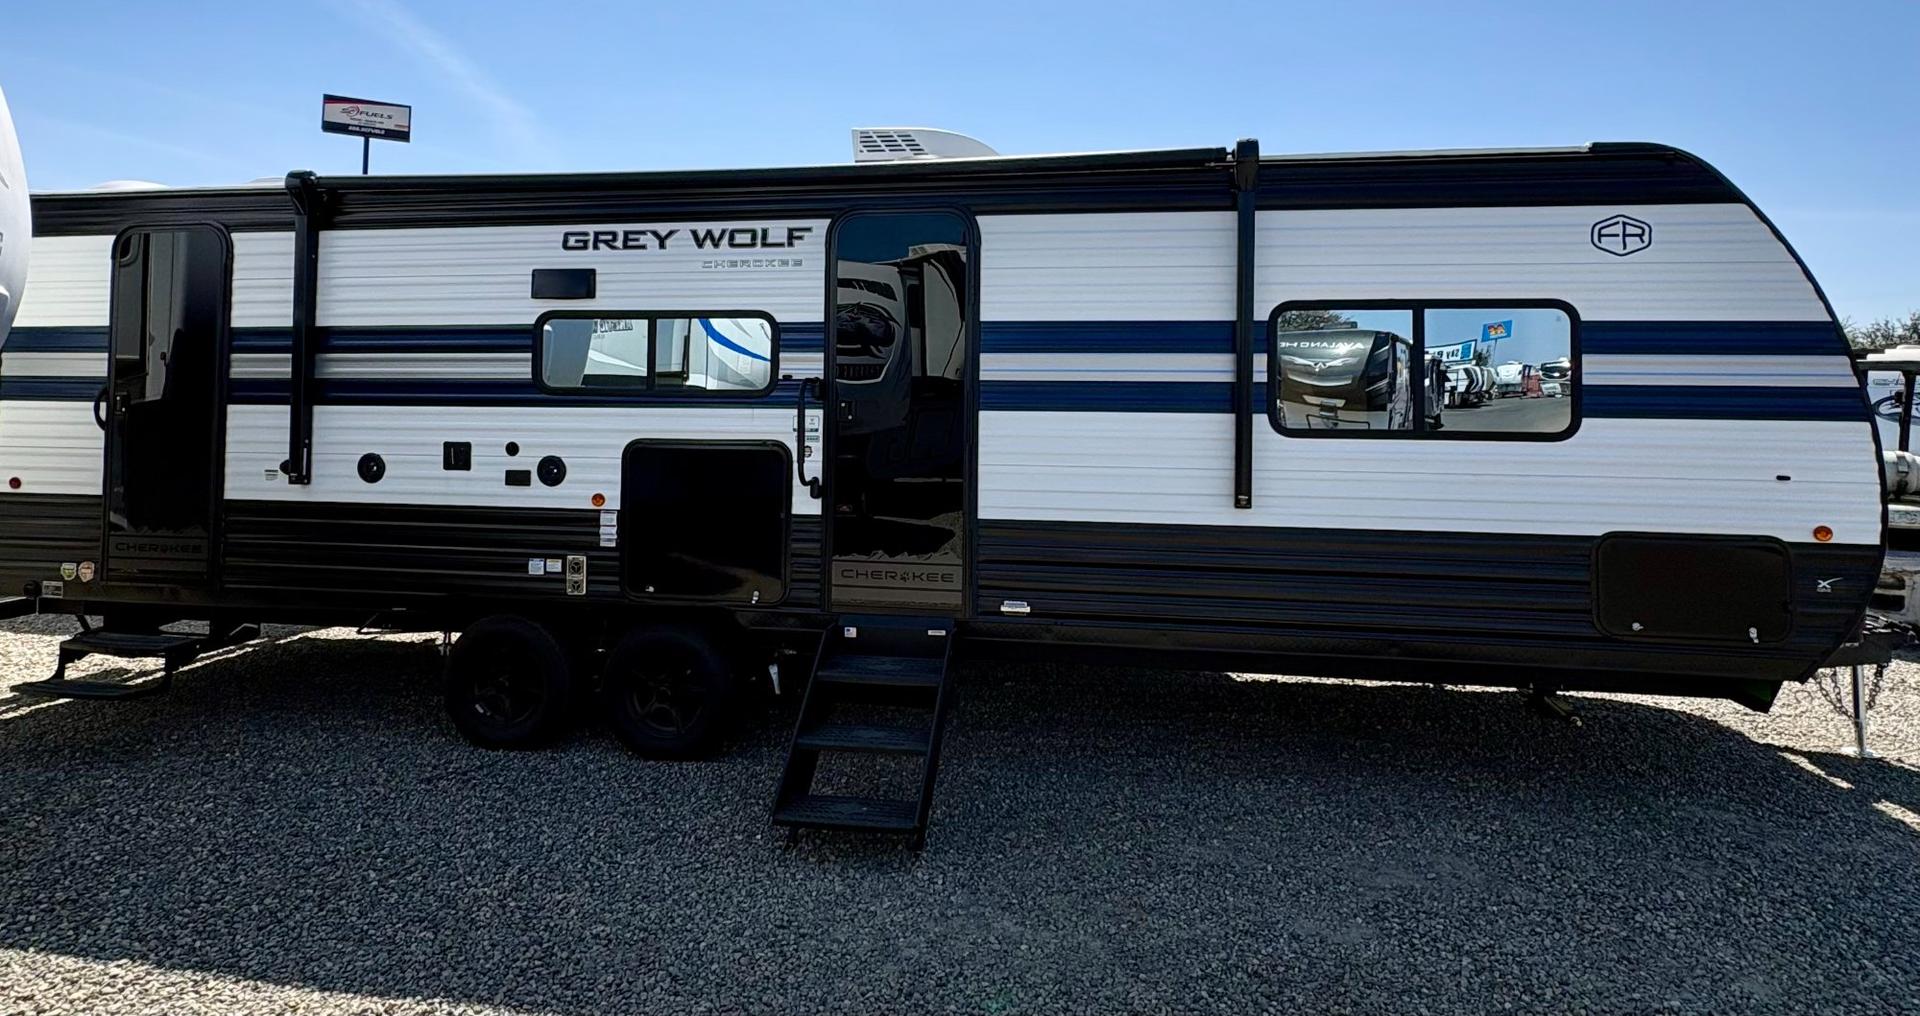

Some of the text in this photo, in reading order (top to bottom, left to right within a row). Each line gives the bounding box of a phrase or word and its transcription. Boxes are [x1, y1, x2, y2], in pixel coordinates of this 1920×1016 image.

[359, 110, 393, 120] FUELS
[562, 226, 813, 251] GREY WOLF
[702, 258, 803, 268] CHEROKEE
[840, 568, 955, 584] CHEROKEE
